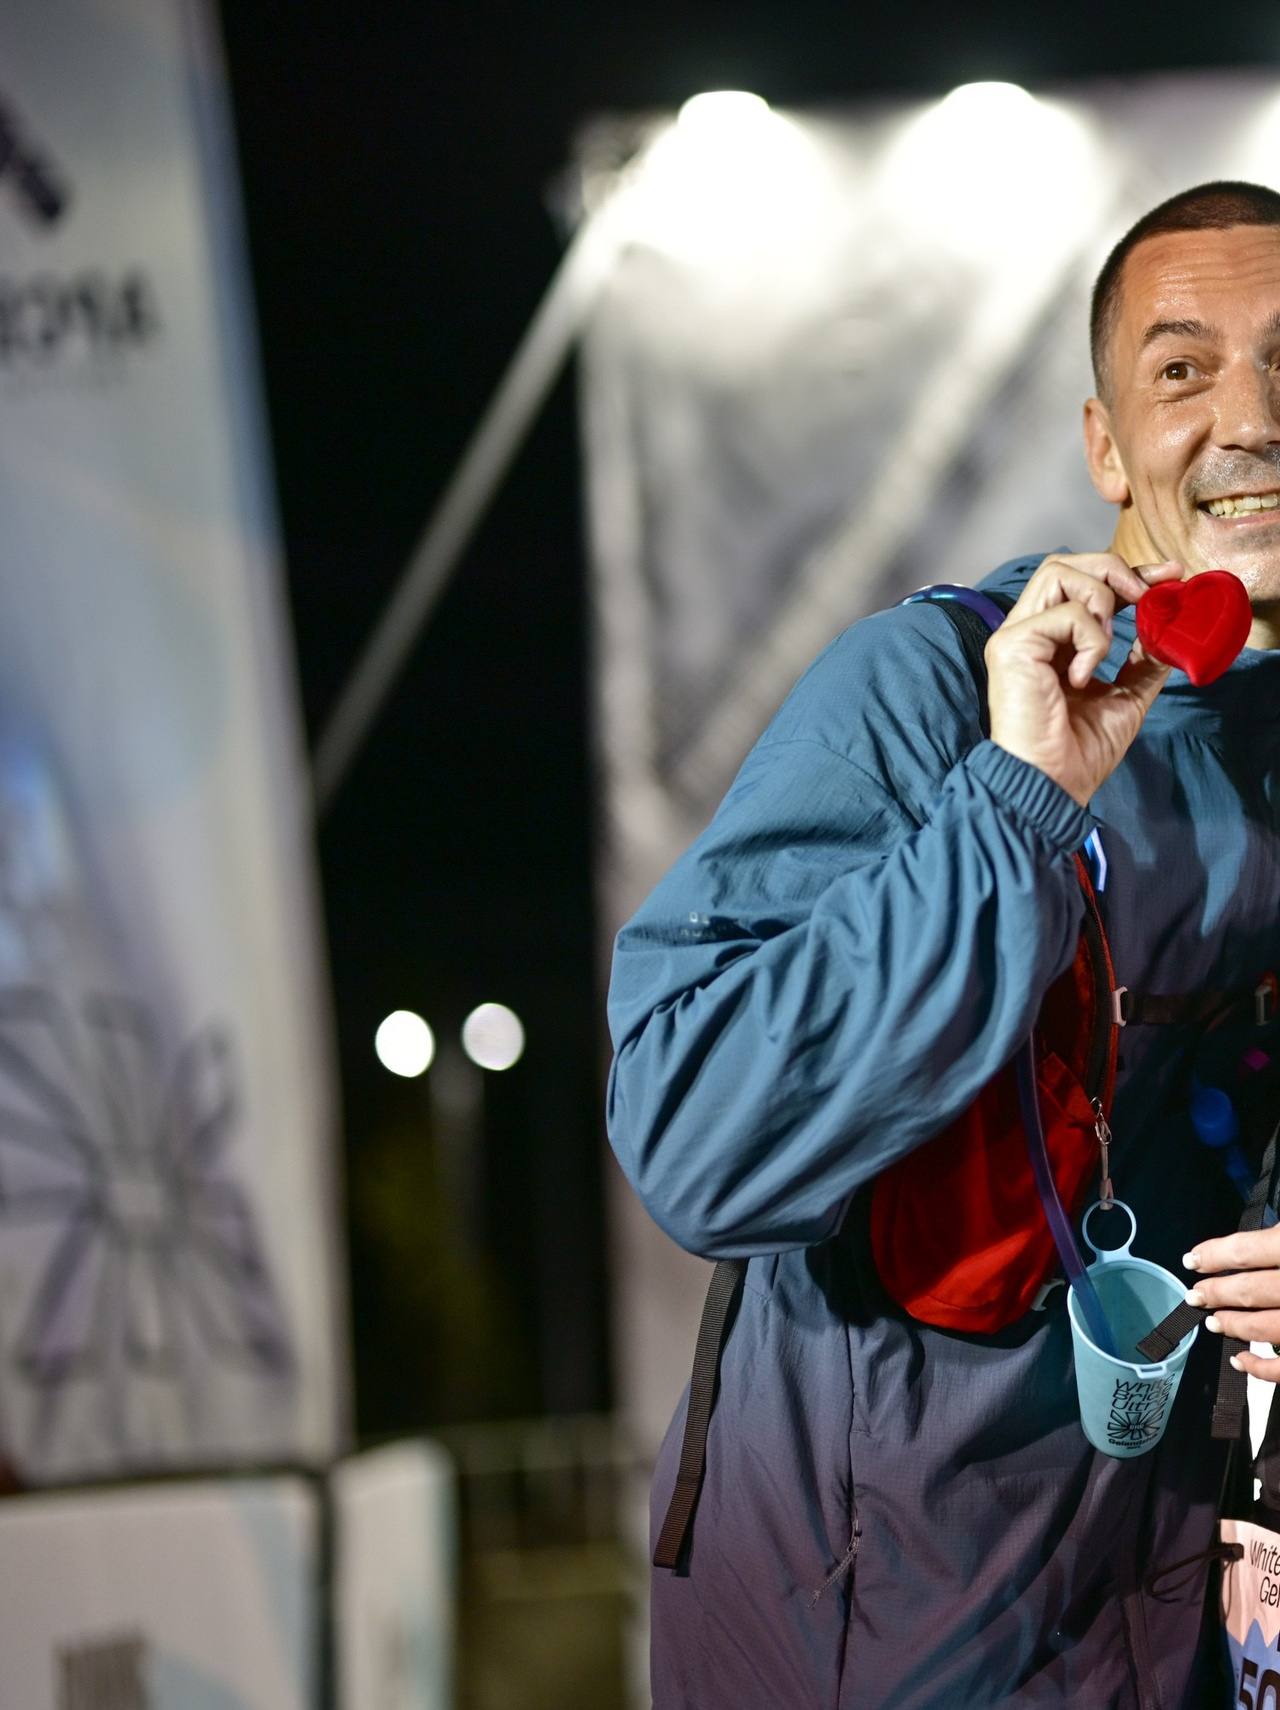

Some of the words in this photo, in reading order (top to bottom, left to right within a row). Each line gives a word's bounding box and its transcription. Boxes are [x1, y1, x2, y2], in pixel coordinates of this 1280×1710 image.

[1113, 1382, 1173, 1402] Bride
[1115, 1372, 1176, 1393] White
[1111, 1392, 1170, 1412] Ultra
